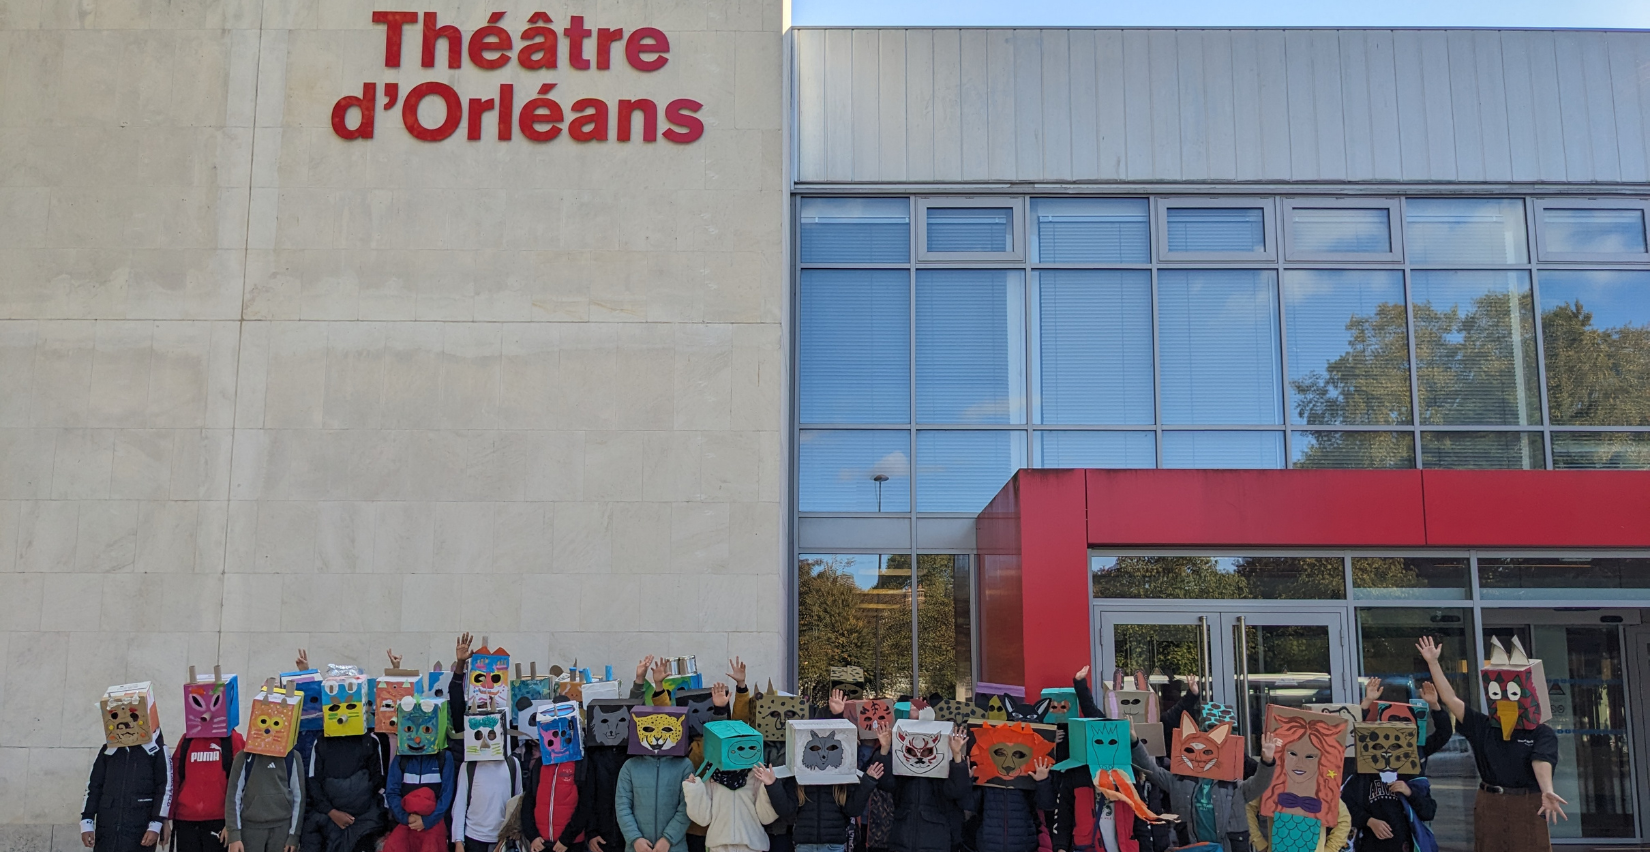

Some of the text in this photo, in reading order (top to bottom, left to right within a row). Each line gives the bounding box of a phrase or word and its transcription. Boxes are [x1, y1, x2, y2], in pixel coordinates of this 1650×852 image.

[373, 11, 670, 72] Théâtre
[331, 81, 704, 143] d’Orléans
[190, 751, 220, 763] PUMA
